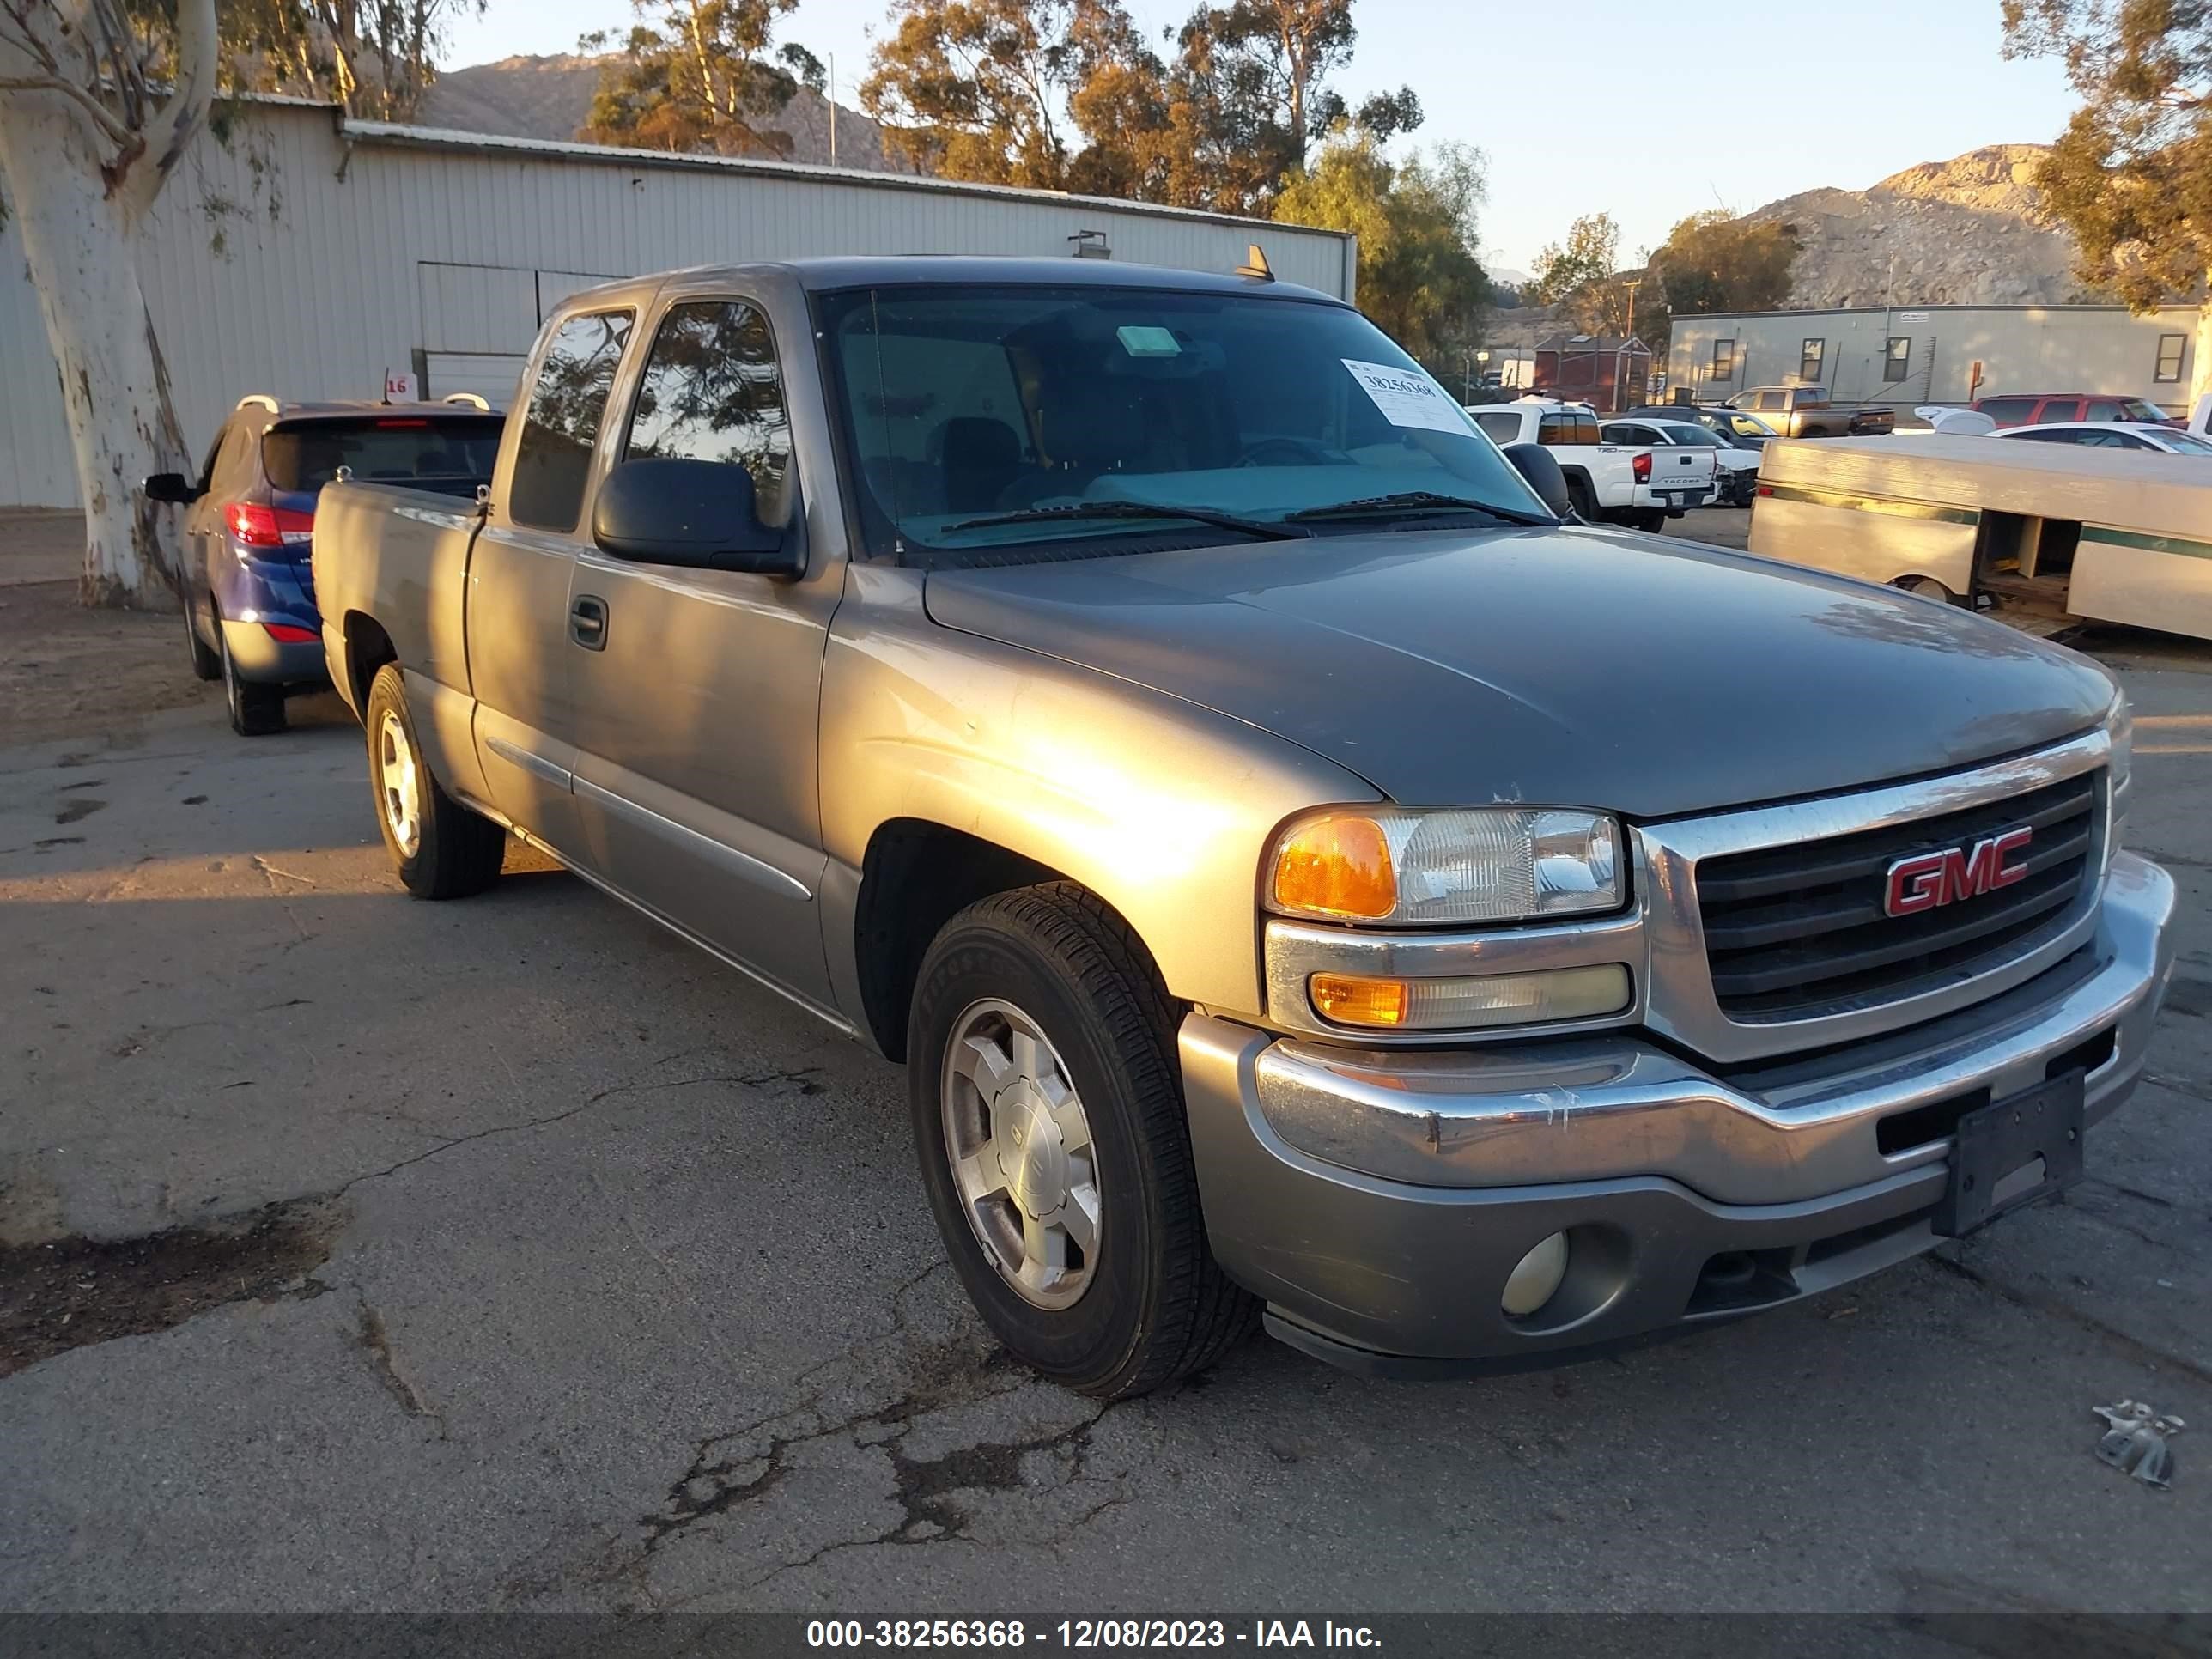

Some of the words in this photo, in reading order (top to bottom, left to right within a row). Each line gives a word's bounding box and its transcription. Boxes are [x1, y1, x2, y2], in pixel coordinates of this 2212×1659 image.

[388, 380, 406, 393] 16
[1364, 375, 1437, 398] 38256368
[1885, 826, 2033, 917] GMC
